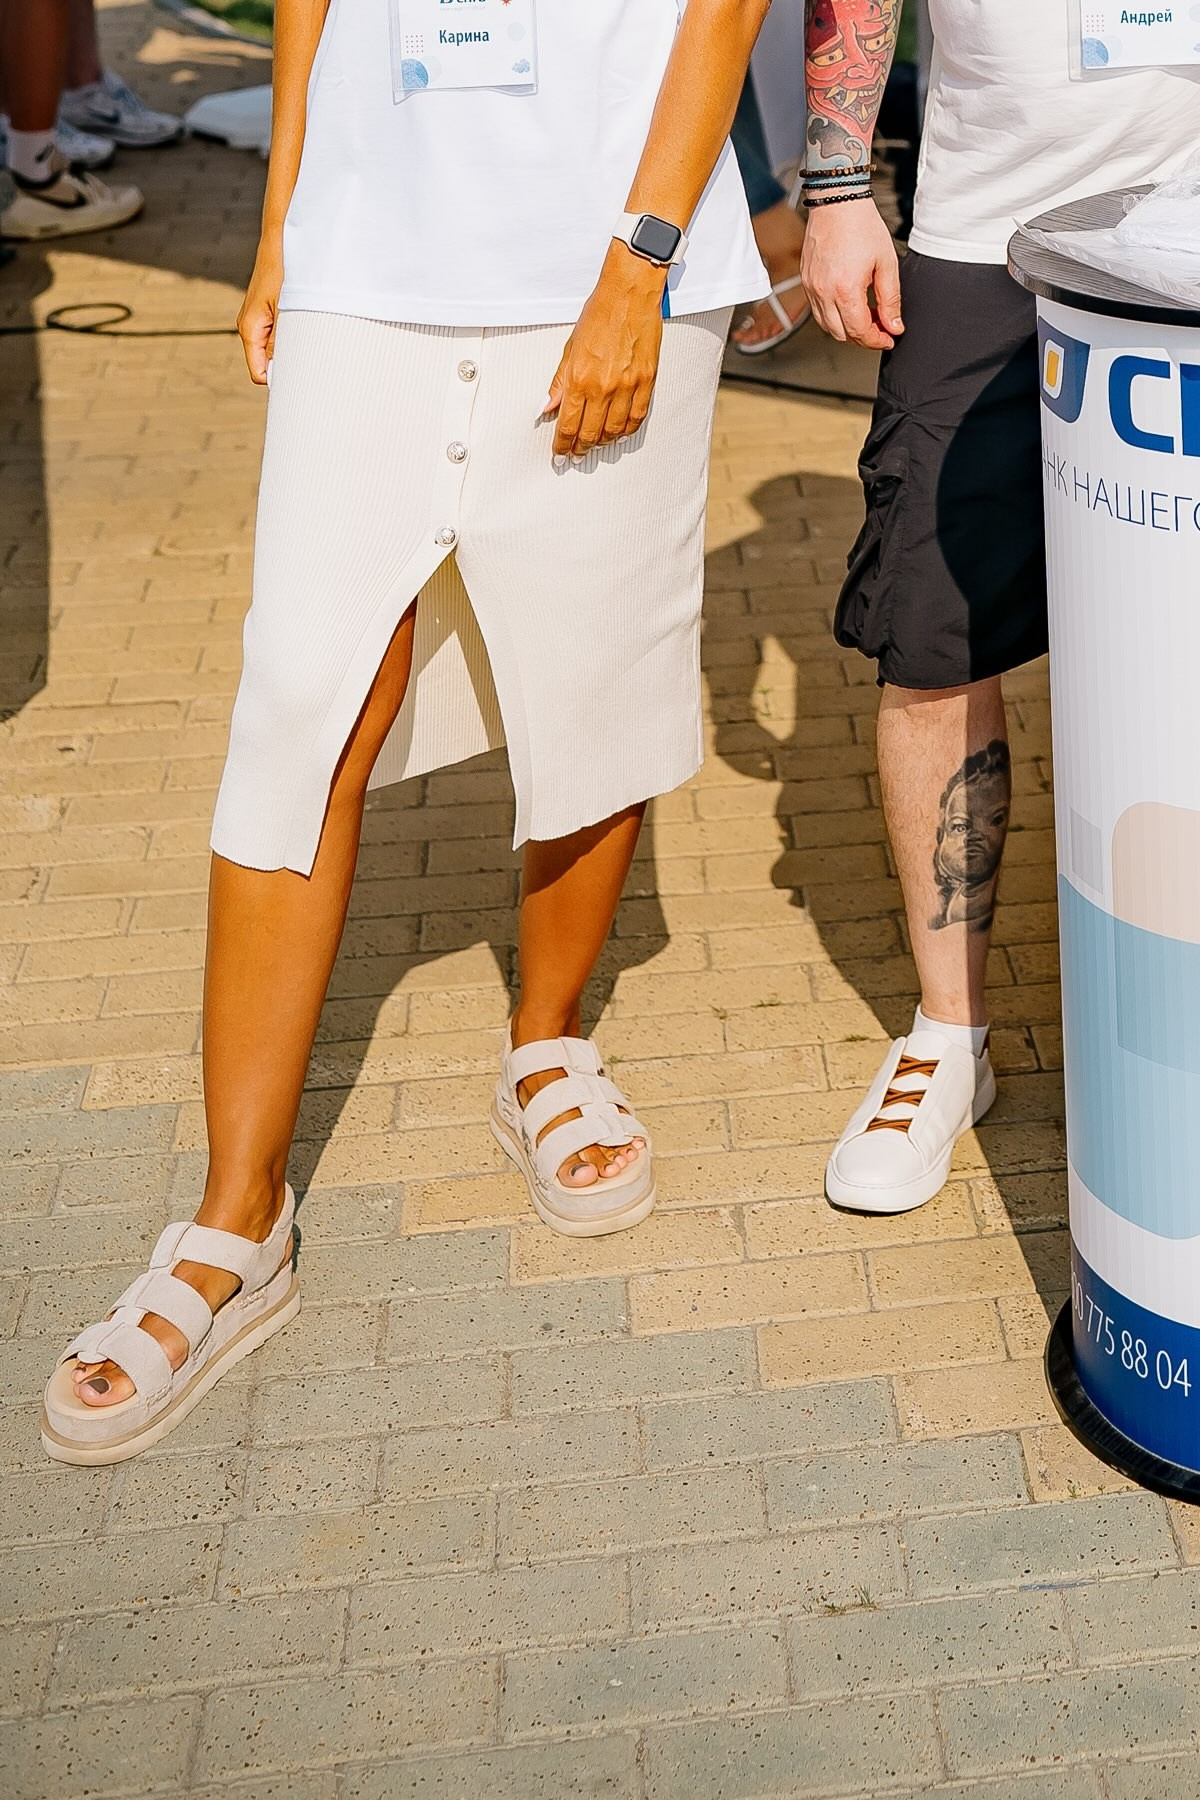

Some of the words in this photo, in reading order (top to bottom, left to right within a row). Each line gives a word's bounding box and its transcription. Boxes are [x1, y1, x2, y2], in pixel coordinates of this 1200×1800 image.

[1120, 8, 1172, 26] Андрей
[440, 29, 489, 46] Карина
[1085, 1294, 1115, 1356] 775
[1121, 1330, 1149, 1379] 88
[1156, 1350, 1193, 1398] 04
